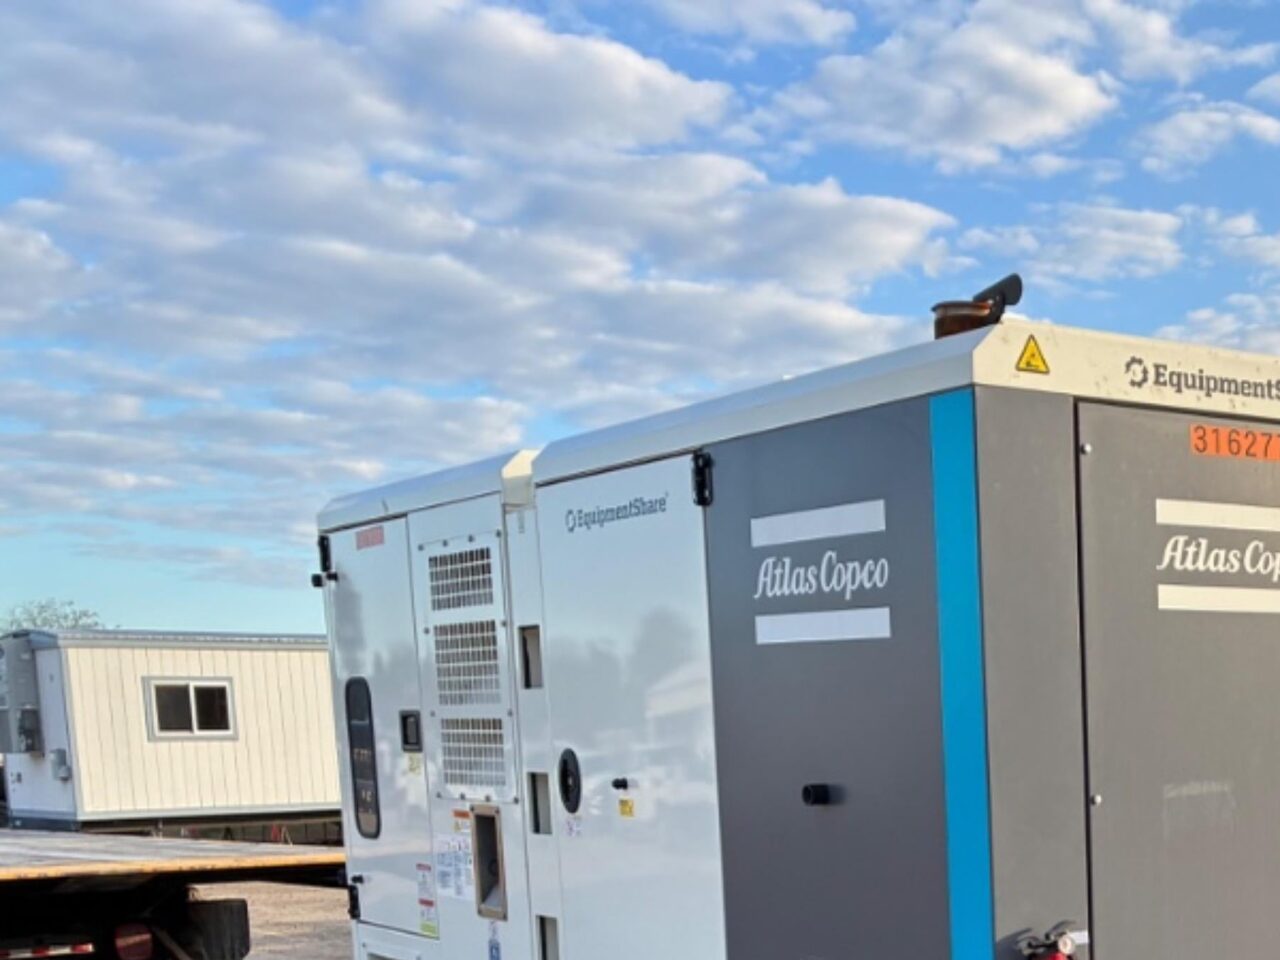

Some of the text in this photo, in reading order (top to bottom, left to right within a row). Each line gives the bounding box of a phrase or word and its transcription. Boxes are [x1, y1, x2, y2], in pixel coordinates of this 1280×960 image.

[577, 496, 667, 531] EquipmentShare
[1156, 534, 1241, 573] Atlas
[753, 550, 889, 601] Atlas Copco
